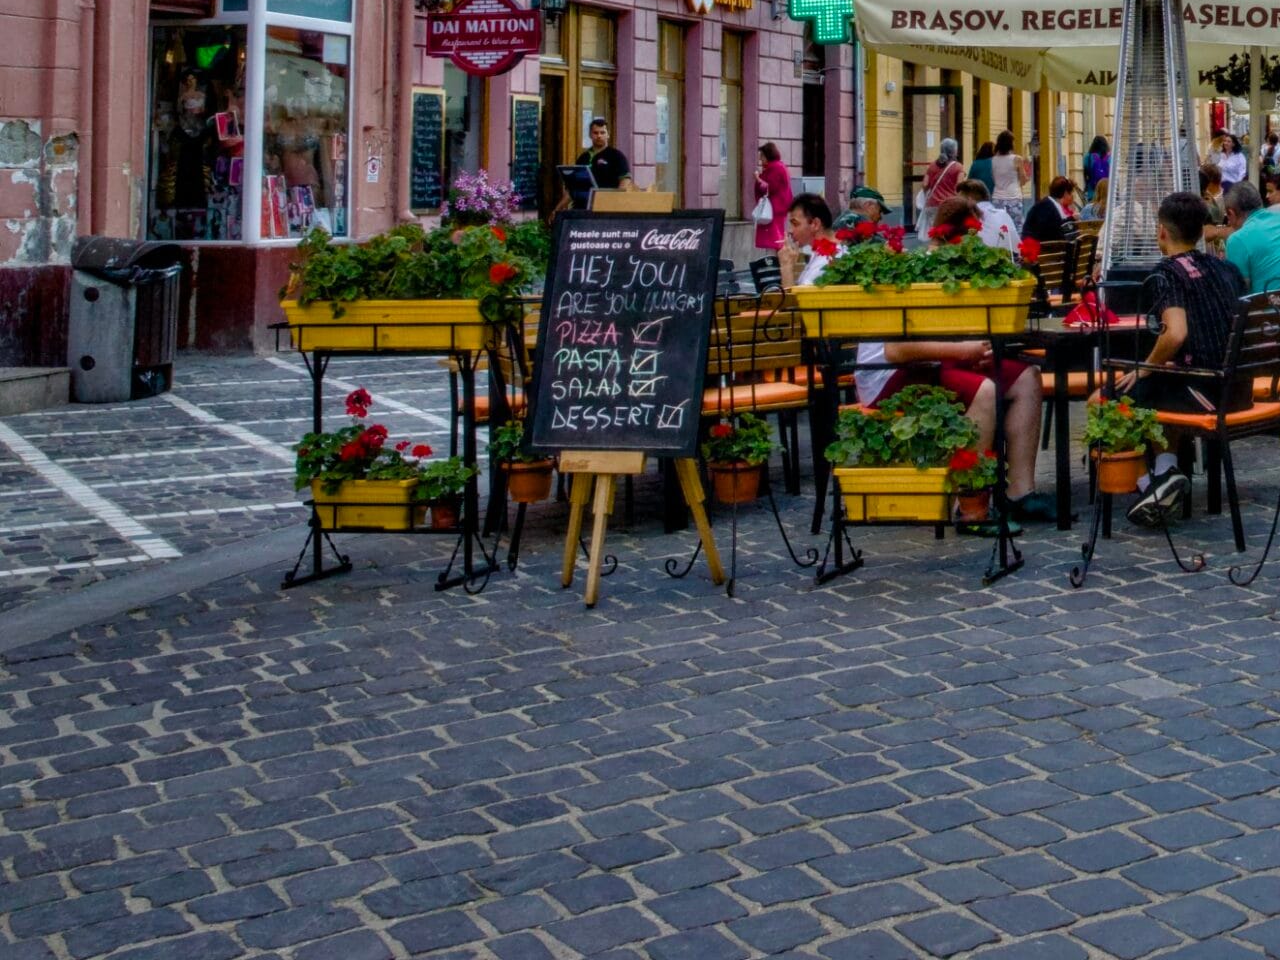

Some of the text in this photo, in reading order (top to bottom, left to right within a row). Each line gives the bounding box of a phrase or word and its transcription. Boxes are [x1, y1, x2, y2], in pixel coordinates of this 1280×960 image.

[432, 18, 535, 34] DAI MATTONI
[891, 8, 1010, 35] BRAȘOV.
[1022, 7, 1123, 29] REGELE
[441, 38, 482, 50] Restaurant
[491, 37, 509, 45] Wine
[569, 230, 639, 238] Mesele sunt mai
[571, 241, 610, 250] gustoase
[641, 228, 705, 250] Coca-Cola
[568, 253, 615, 288] HEY
[556, 290, 600, 319] ARE
[604, 290, 637, 315] YOU
[555, 319, 623, 347] PIZZA
[553, 348, 625, 376] PASTA
[551, 377, 622, 400] SALAD
[551, 404, 655, 430] DESSERT
